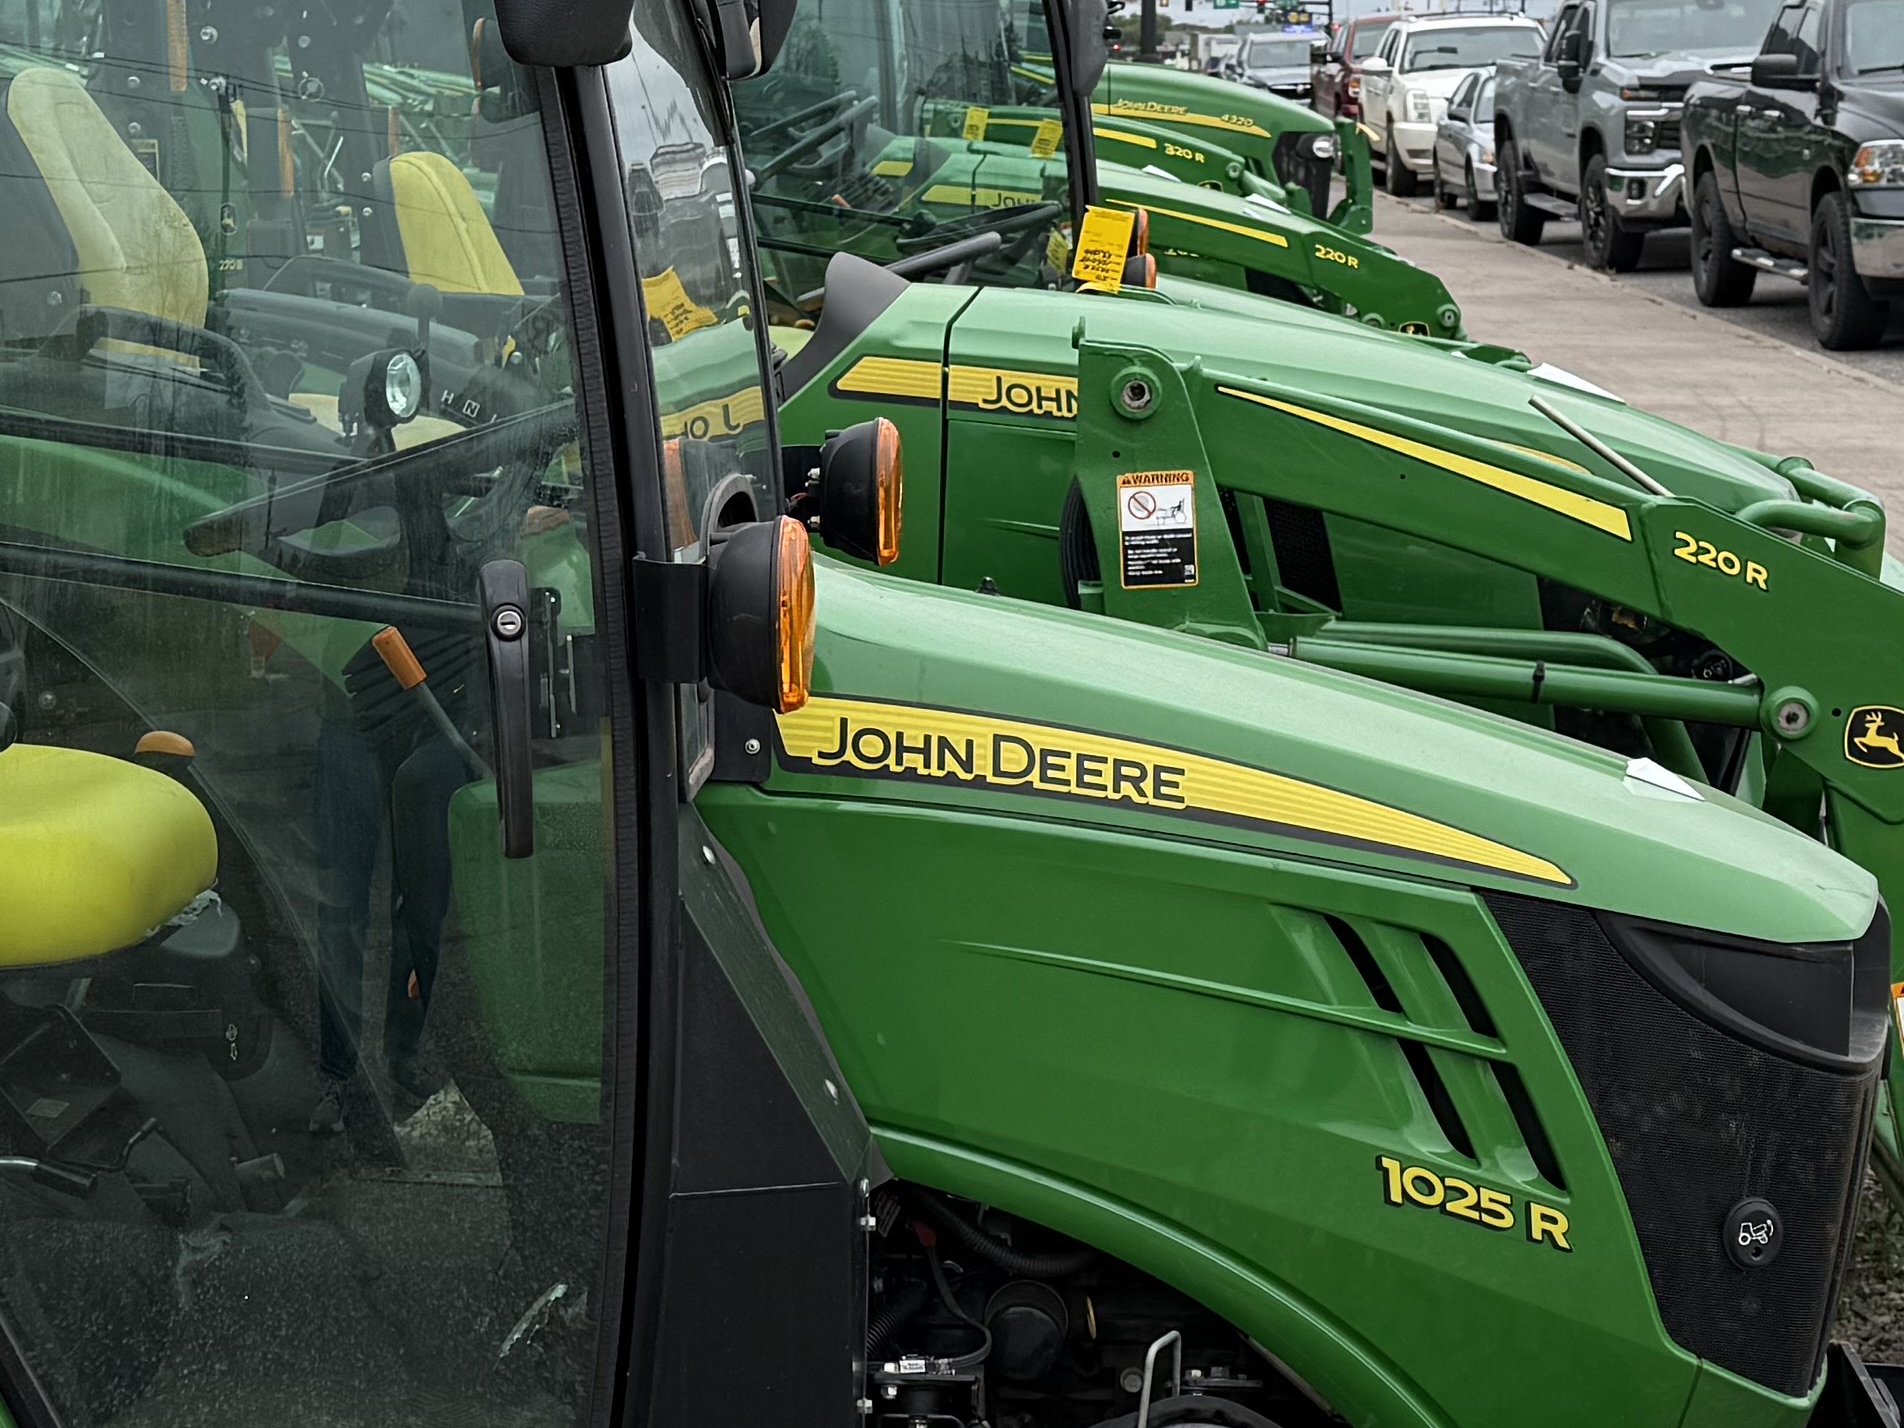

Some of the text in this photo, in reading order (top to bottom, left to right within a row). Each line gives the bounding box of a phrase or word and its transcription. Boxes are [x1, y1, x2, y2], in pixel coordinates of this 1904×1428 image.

[1315, 244, 1346, 265] 220
[1132, 473, 1190, 484] WARNING
[1674, 531, 1769, 591] 220 R
[817, 717, 1186, 804] JOHN DEERE
[1377, 1156, 1572, 1251] 1025 R
